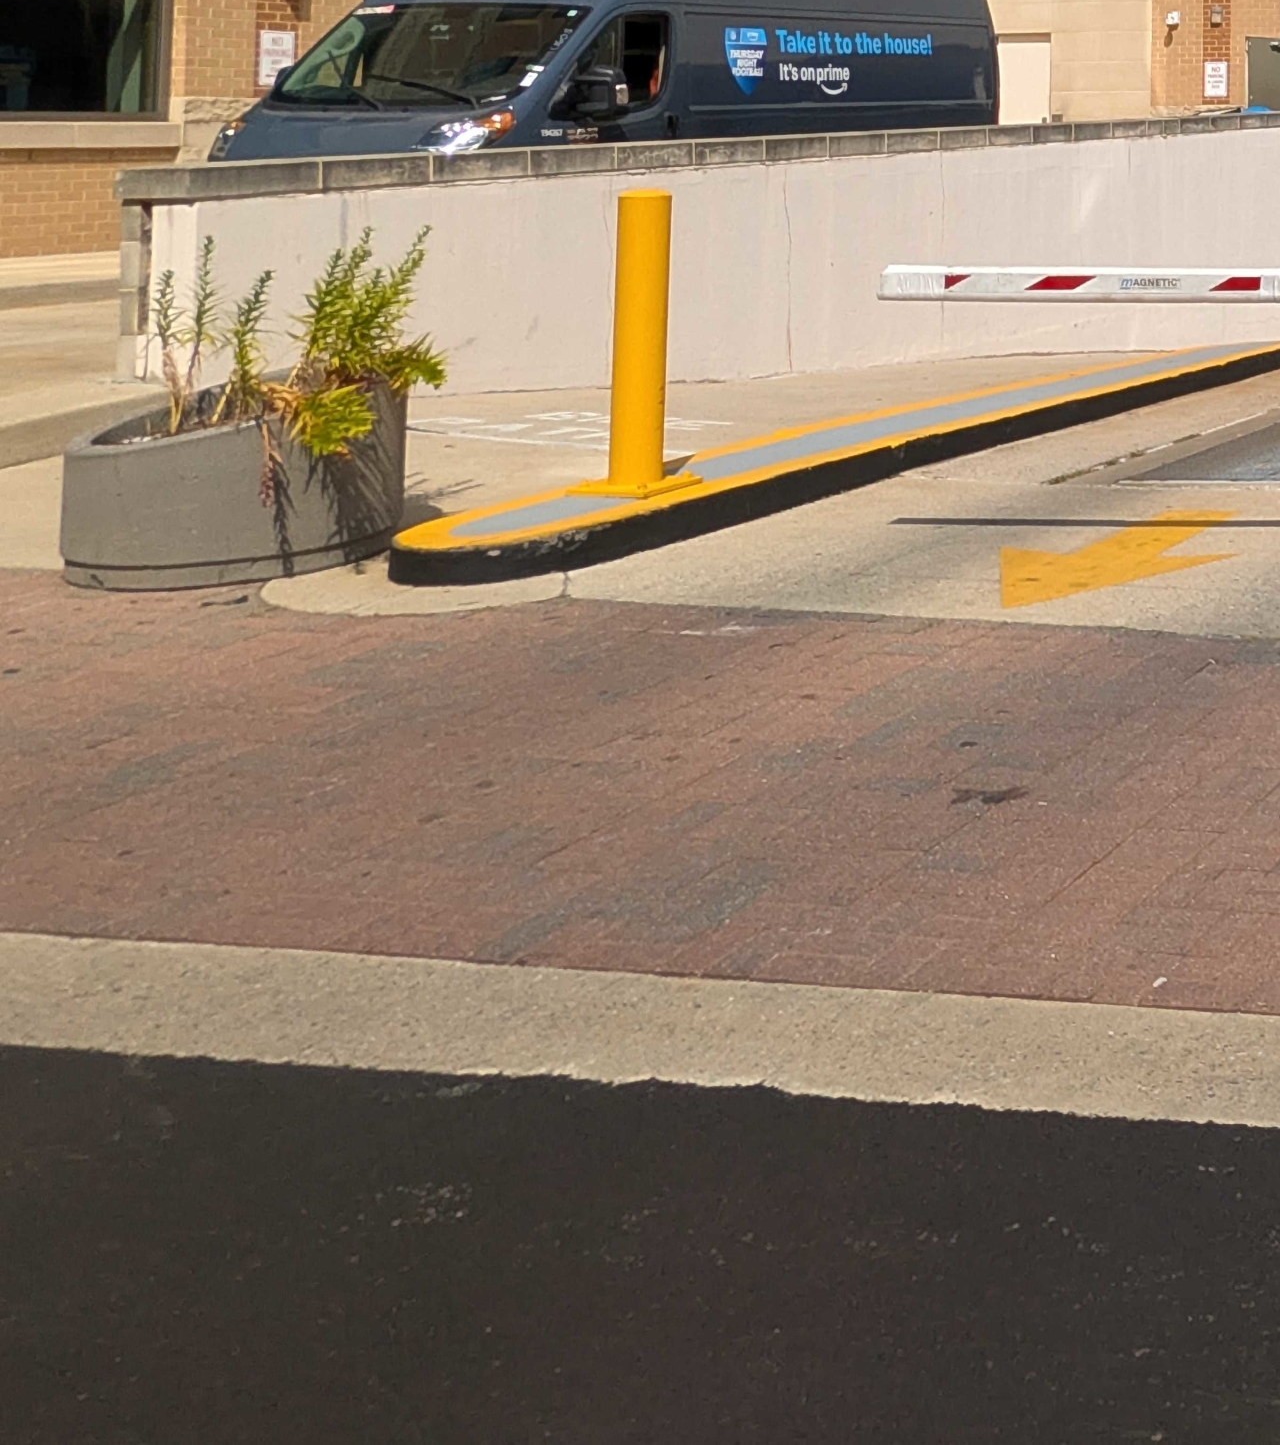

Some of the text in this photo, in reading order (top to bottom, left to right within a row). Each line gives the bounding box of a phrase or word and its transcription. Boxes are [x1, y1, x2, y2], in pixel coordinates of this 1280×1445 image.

[775, 29, 816, 53] Take
[818, 31, 833, 54] it
[834, 32, 853, 54] to
[855, 32, 882, 54] the
[884, 32, 932, 55] house!
[736, 58, 758, 68] NIGHT
[779, 63, 850, 85] It's on prime
